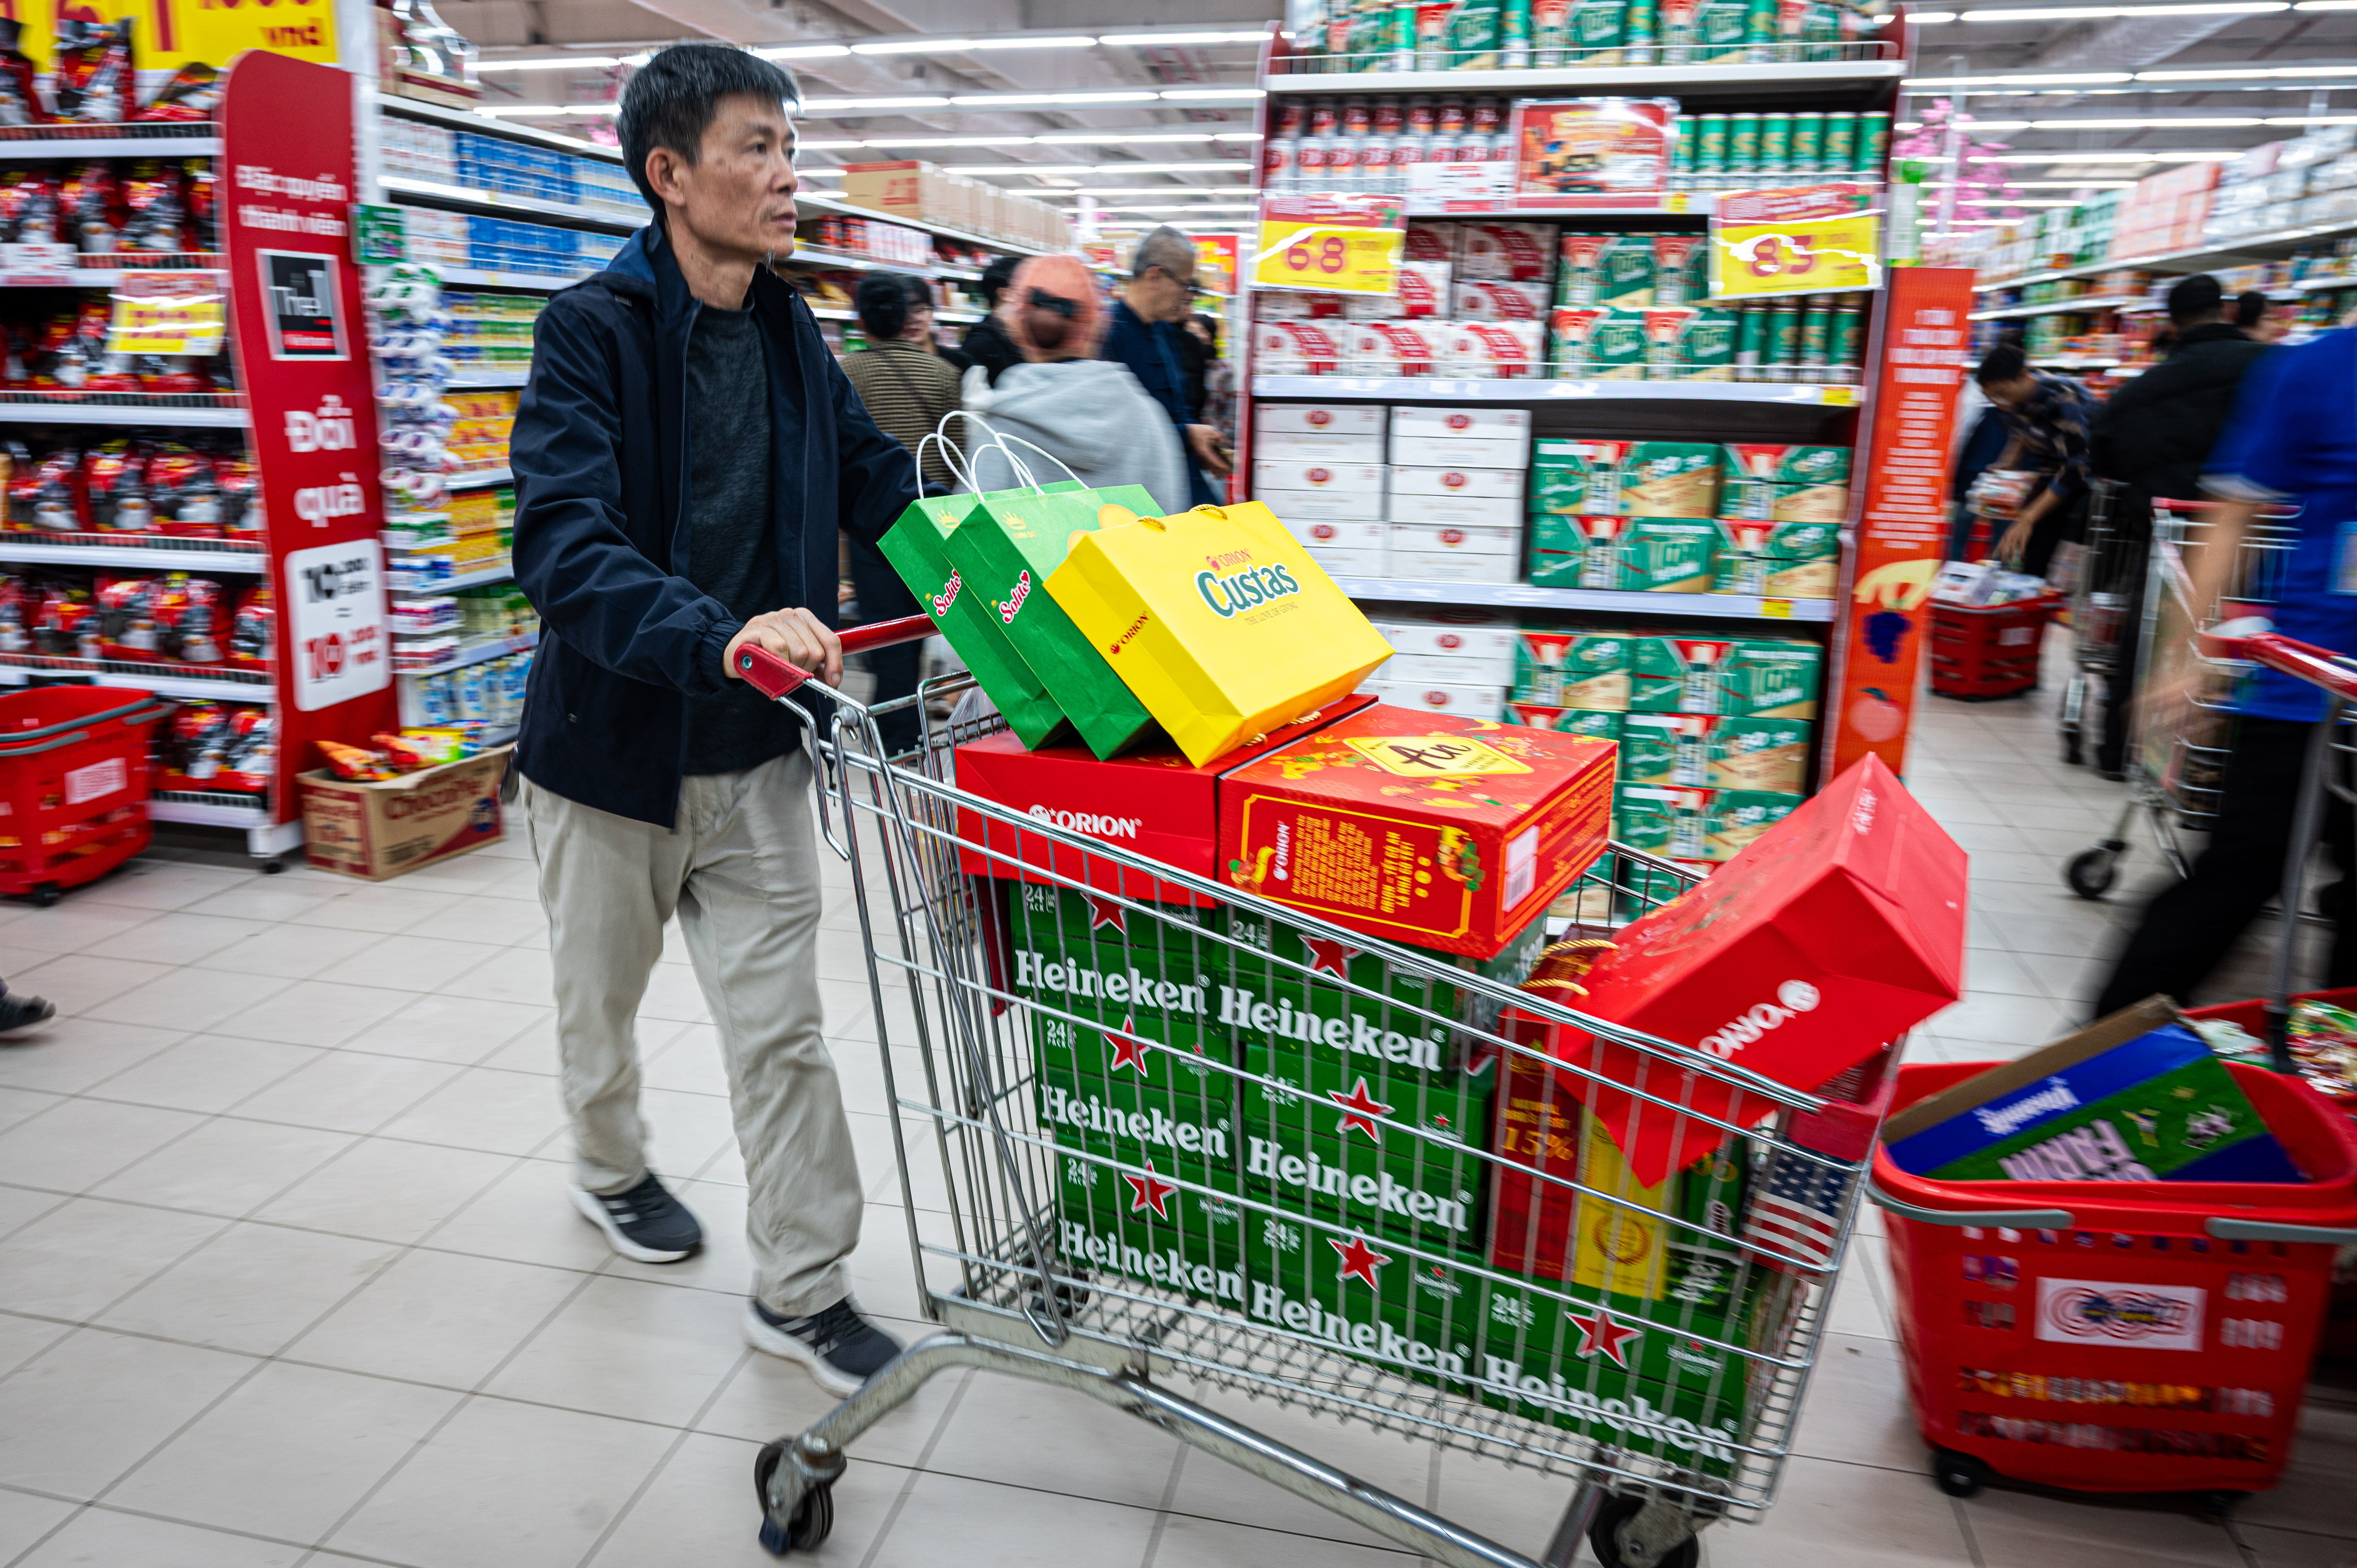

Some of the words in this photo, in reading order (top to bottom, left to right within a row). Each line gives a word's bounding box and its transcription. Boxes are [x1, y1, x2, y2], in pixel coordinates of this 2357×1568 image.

[933, 575, 961, 616] Solite
[999, 580, 1031, 624] Solite
[1197, 564, 1298, 617] Custas
[1056, 810, 1136, 839] ORION
[1025, 884, 1044, 904] 24
[1232, 920, 1257, 943] 24
[1015, 949, 1209, 1015] Heineken
[1046, 1019, 1067, 1041] 24
[1217, 984, 1442, 1072] Heineken
[1041, 1083, 1229, 1159] Heineken
[1500, 1126, 1574, 1159] 15%
[1067, 1157, 1087, 1179] 24
[1247, 1136, 1468, 1232] Heineken
[1058, 1218, 1245, 1302] Heineken
[1491, 1292, 1522, 1319] 24
[1250, 1279, 1465, 1385] Heineken
[1482, 1353, 1736, 1464] Heineken
